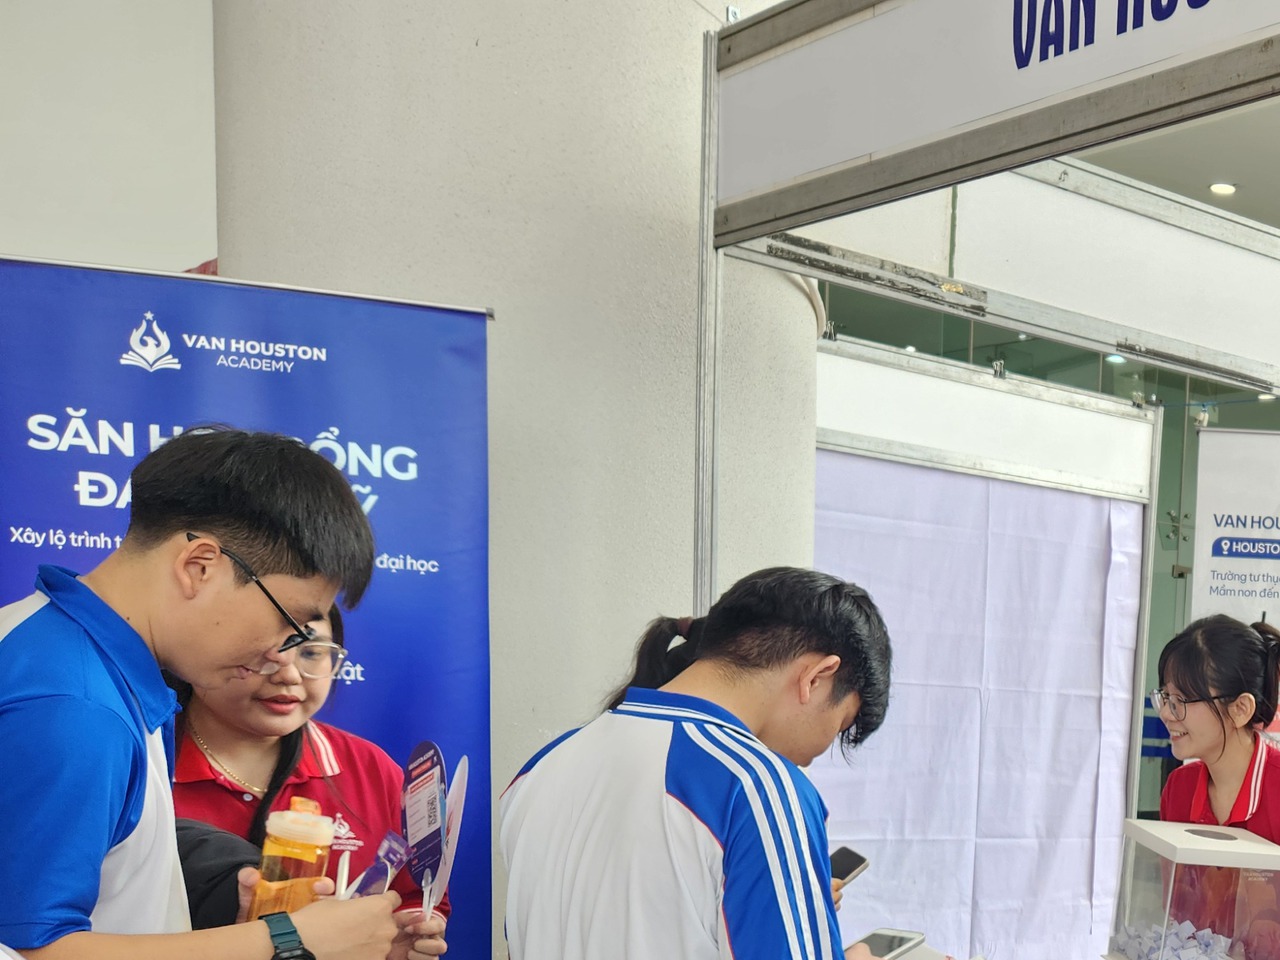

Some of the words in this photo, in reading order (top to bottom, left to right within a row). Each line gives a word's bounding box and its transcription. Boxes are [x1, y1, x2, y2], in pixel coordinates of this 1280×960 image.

[182, 333, 225, 351] VAN
[230, 338, 327, 361] HOUSTON
[216, 354, 295, 373] ACADEMY
[27, 406, 135, 457] SĂN
[291, 426, 418, 481] ỔNG
[1213, 513, 1248, 530] VAN
[9, 526, 47, 548] Xây
[49, 528, 67, 550] lộ
[69, 530, 112, 549] trình
[375, 552, 404, 573] đại
[406, 554, 440, 575] học
[1210, 569, 1248, 585] Trường
[1237, 588, 1257, 598] non
[1259, 586, 1280, 599] đến
